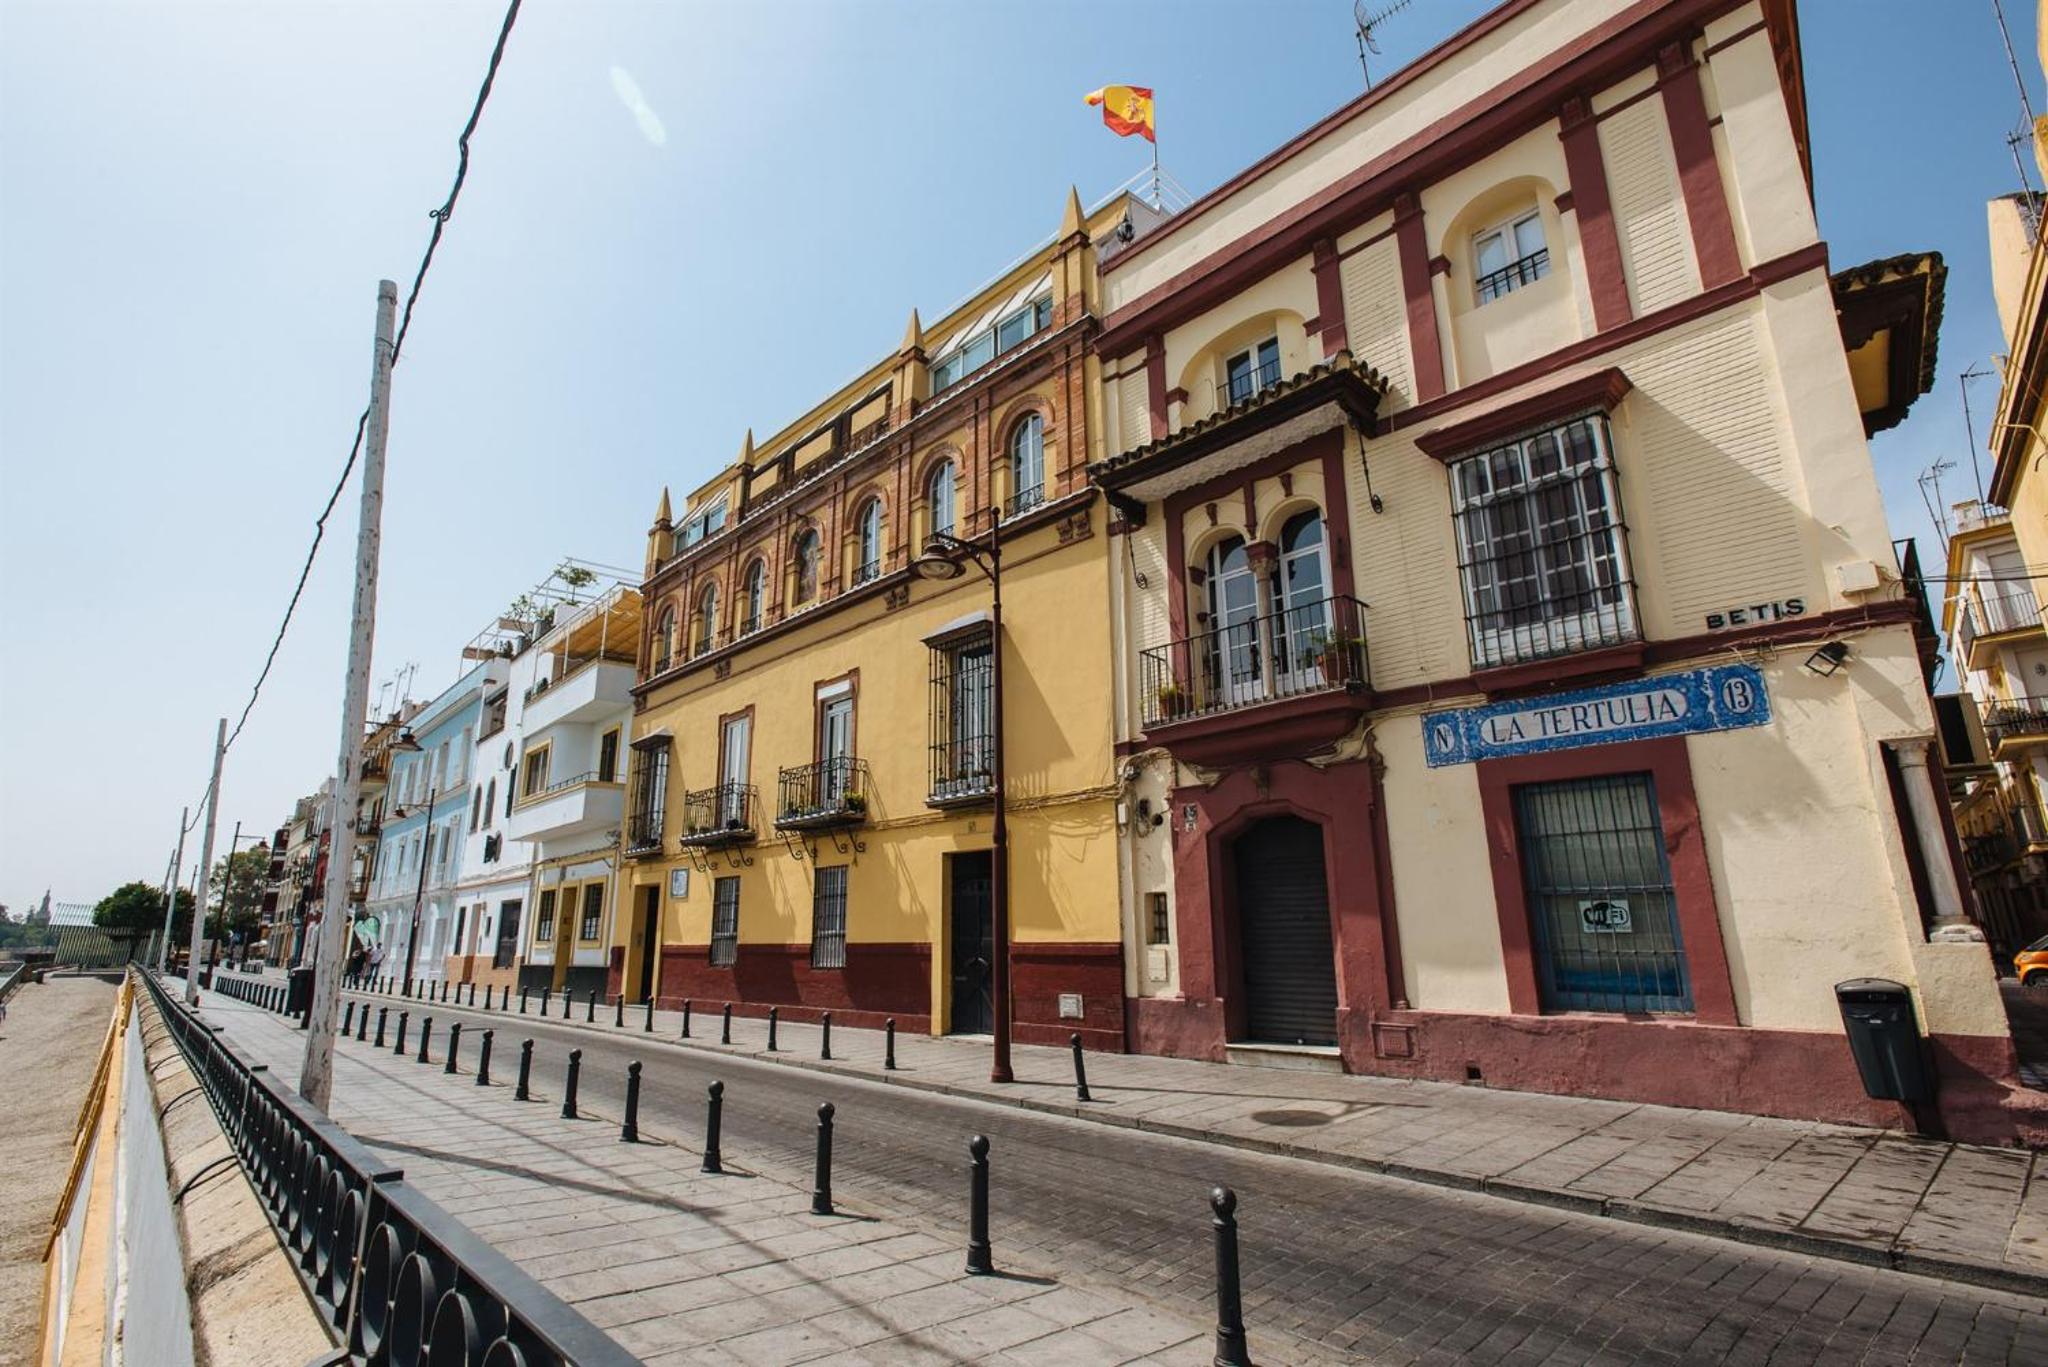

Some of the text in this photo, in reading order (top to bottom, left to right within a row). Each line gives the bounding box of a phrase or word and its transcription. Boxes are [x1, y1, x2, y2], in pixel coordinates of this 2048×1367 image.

[1706, 599, 1804, 629] BETIS
[1490, 716, 1525, 742] LA
[1533, 692, 1679, 737] TERTULIA
[1726, 681, 1750, 709] 13
